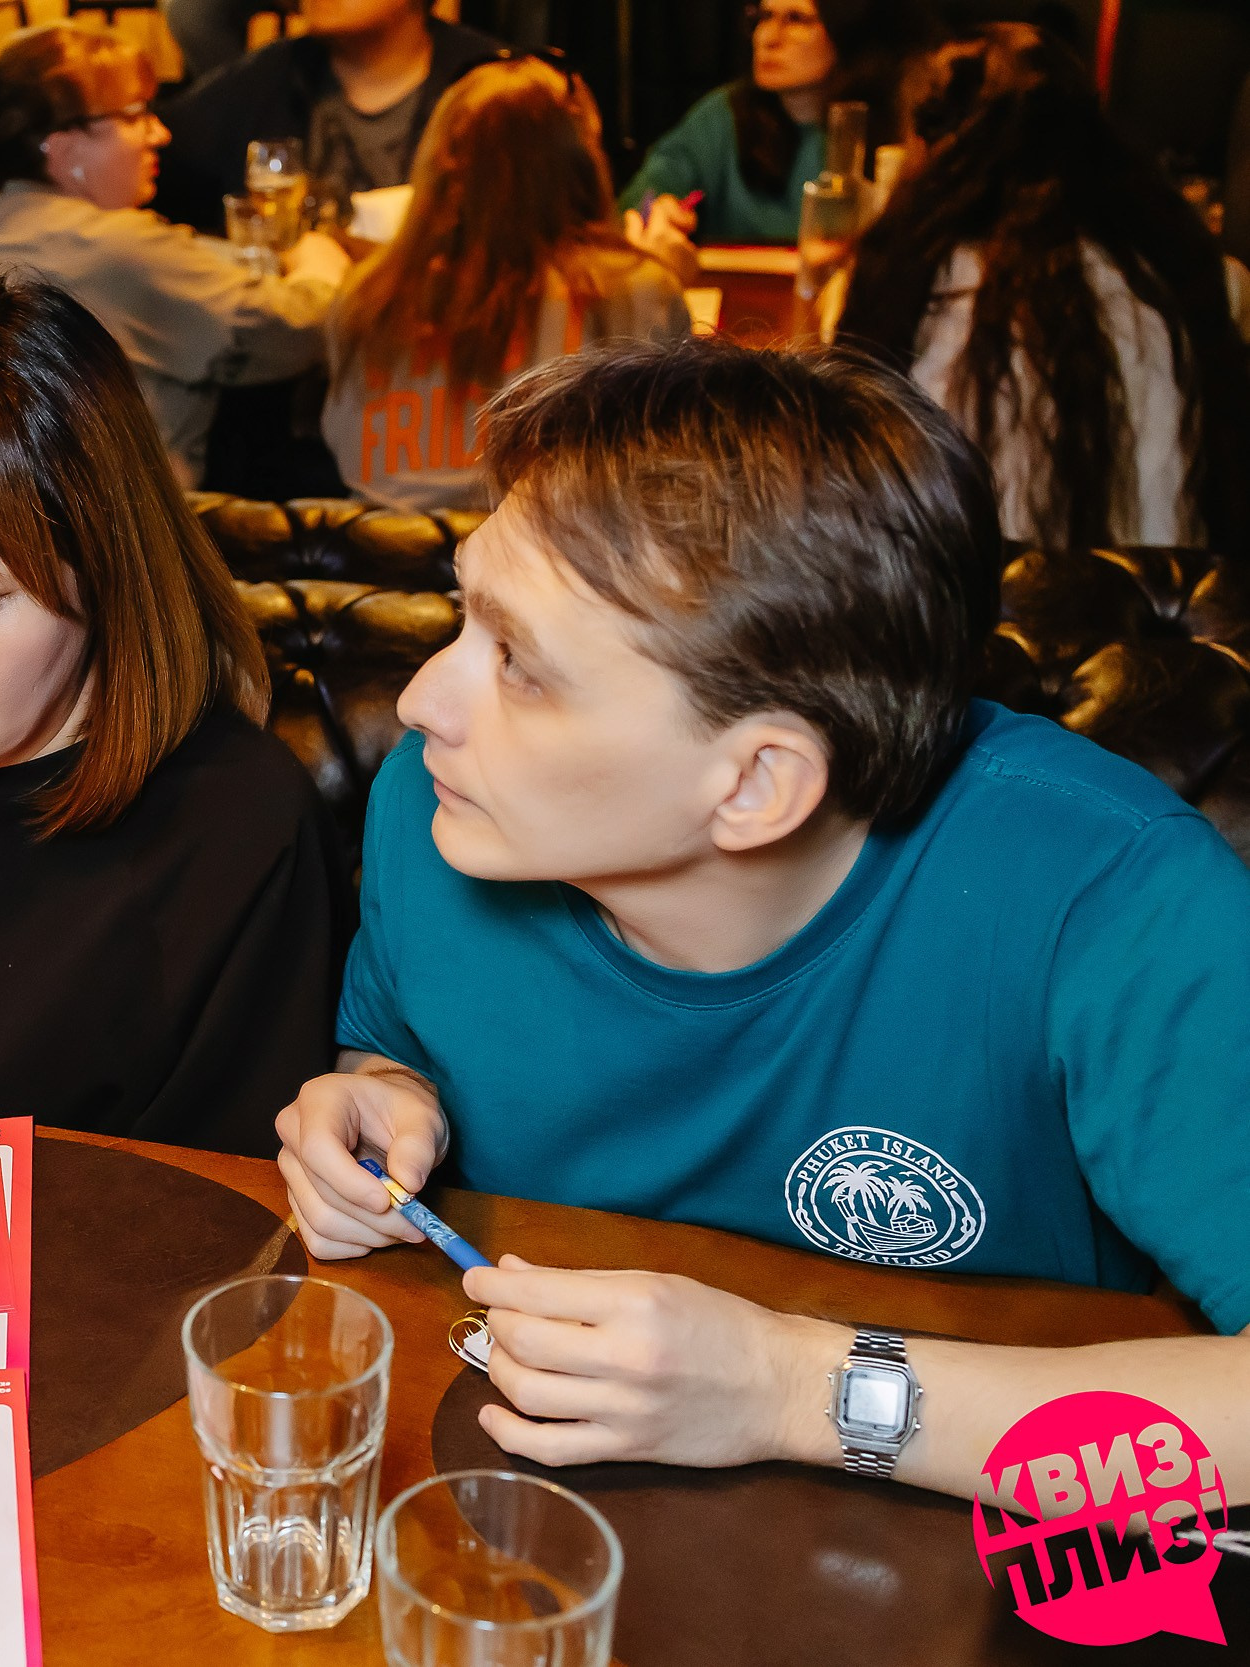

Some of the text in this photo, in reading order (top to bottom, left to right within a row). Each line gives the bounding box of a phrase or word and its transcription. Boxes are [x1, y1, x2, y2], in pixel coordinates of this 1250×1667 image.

[796, 1133, 959, 1191] PHUKET ISLAND
[833, 1243, 952, 1265] THAILAND
